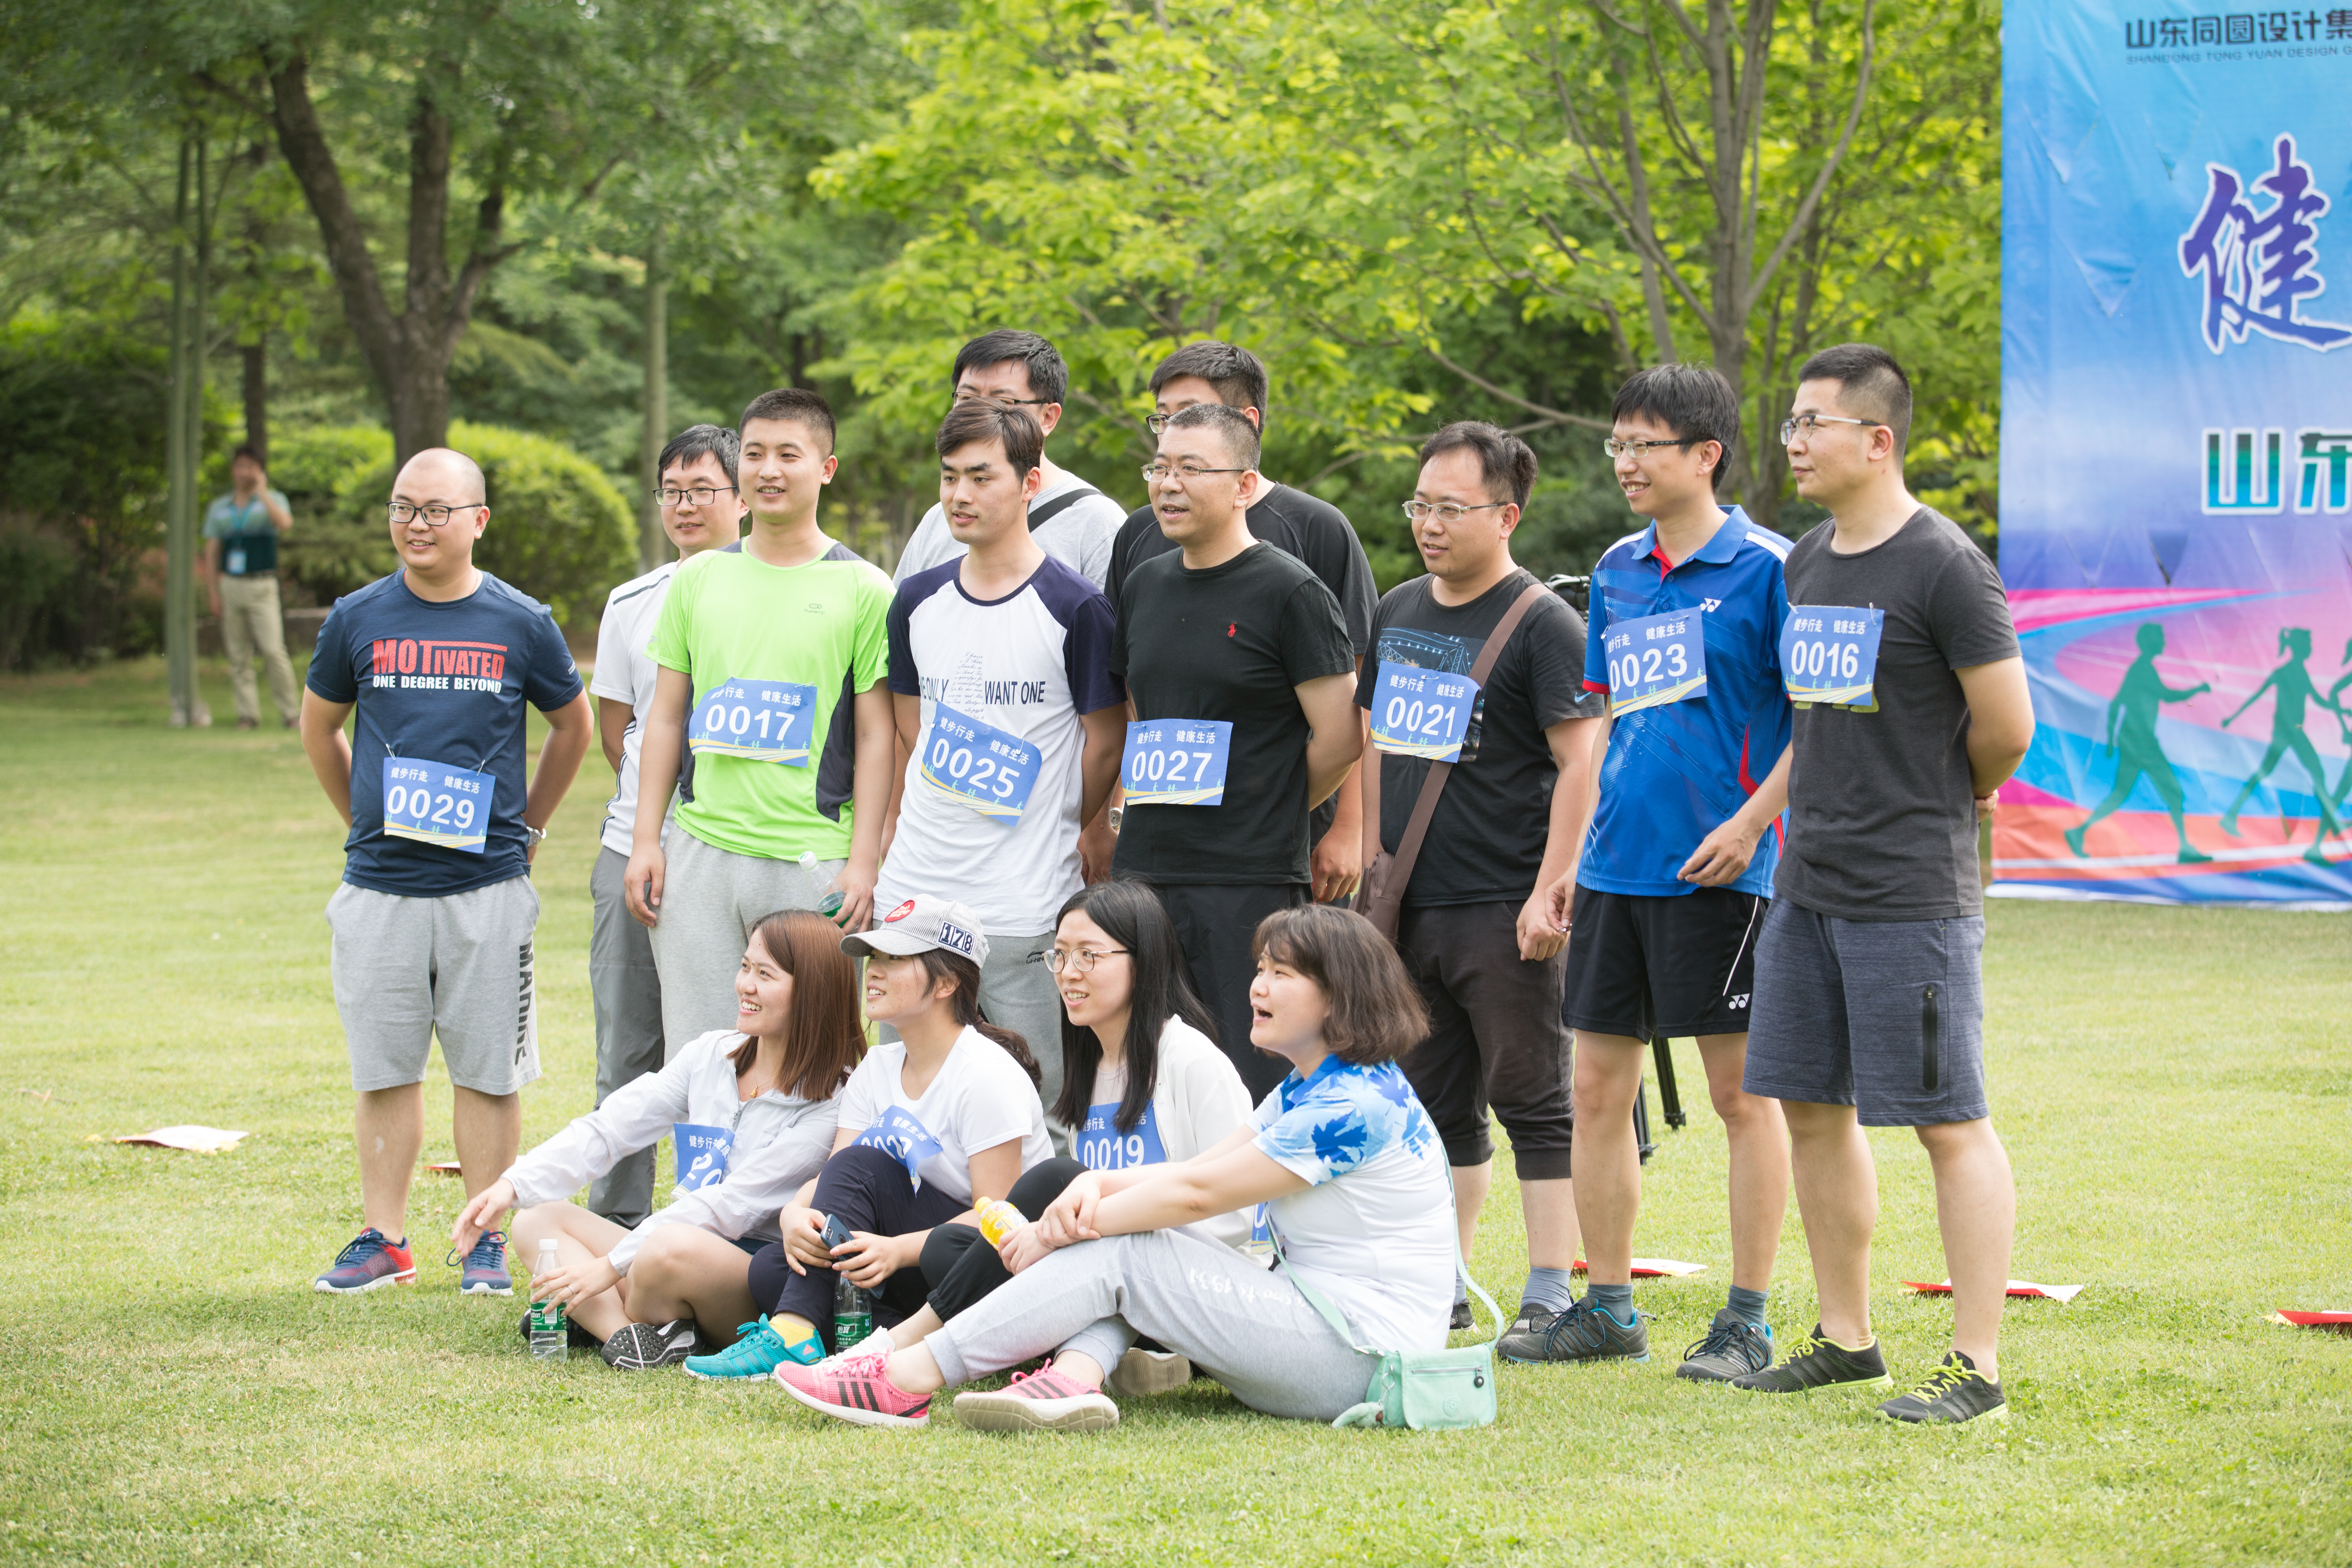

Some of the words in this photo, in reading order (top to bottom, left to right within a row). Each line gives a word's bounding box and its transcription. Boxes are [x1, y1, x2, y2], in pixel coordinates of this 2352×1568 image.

[2126, 50, 2201, 65] SHANDONG
[2207, 50, 2243, 62] TONG
[2247, 49, 2283, 59] YUAN
[2287, 46, 2337, 58] DESIGN
[2179, 133, 2352, 354] 健
[1646, 621, 1686, 641] 健康生活
[1793, 618, 1822, 633] 健步行走
[1833, 620, 1866, 635] 健康生活
[373, 639, 507, 680] MOTIVATED
[1610, 644, 1687, 693] 0023
[1791, 640, 1859, 678] 0016
[373, 675, 396, 688] ONE
[401, 676, 449, 690] DEGREE
[454, 677, 502, 694] BEYOND
[761, 690, 802, 706] 健康生活
[927, 677, 949, 702] ONLY
[985, 681, 1018, 705] WANT
[1021, 681, 1045, 704] ONE
[1390, 675, 1424, 692] 健步行走
[1437, 683, 1464, 698] 健康生活
[706, 704, 795, 741] 0017
[1386, 697, 1456, 737] 0021
[940, 716, 975, 742] 健步行走
[990, 740, 1029, 765] 健康生活
[1137, 730, 1162, 744] 健步行走
[1176, 730, 1216, 744] 健康生活
[391, 767, 428, 782] 健步行走
[444, 775, 480, 794] 健康生活
[932, 738, 1020, 797] 0025
[1132, 750, 1212, 782] 0027
[387, 786, 475, 829] 0029
[941, 923, 973, 952] 178
[892, 1116, 928, 1141] 健康生活
[1084, 1134, 1144, 1170] 0019
